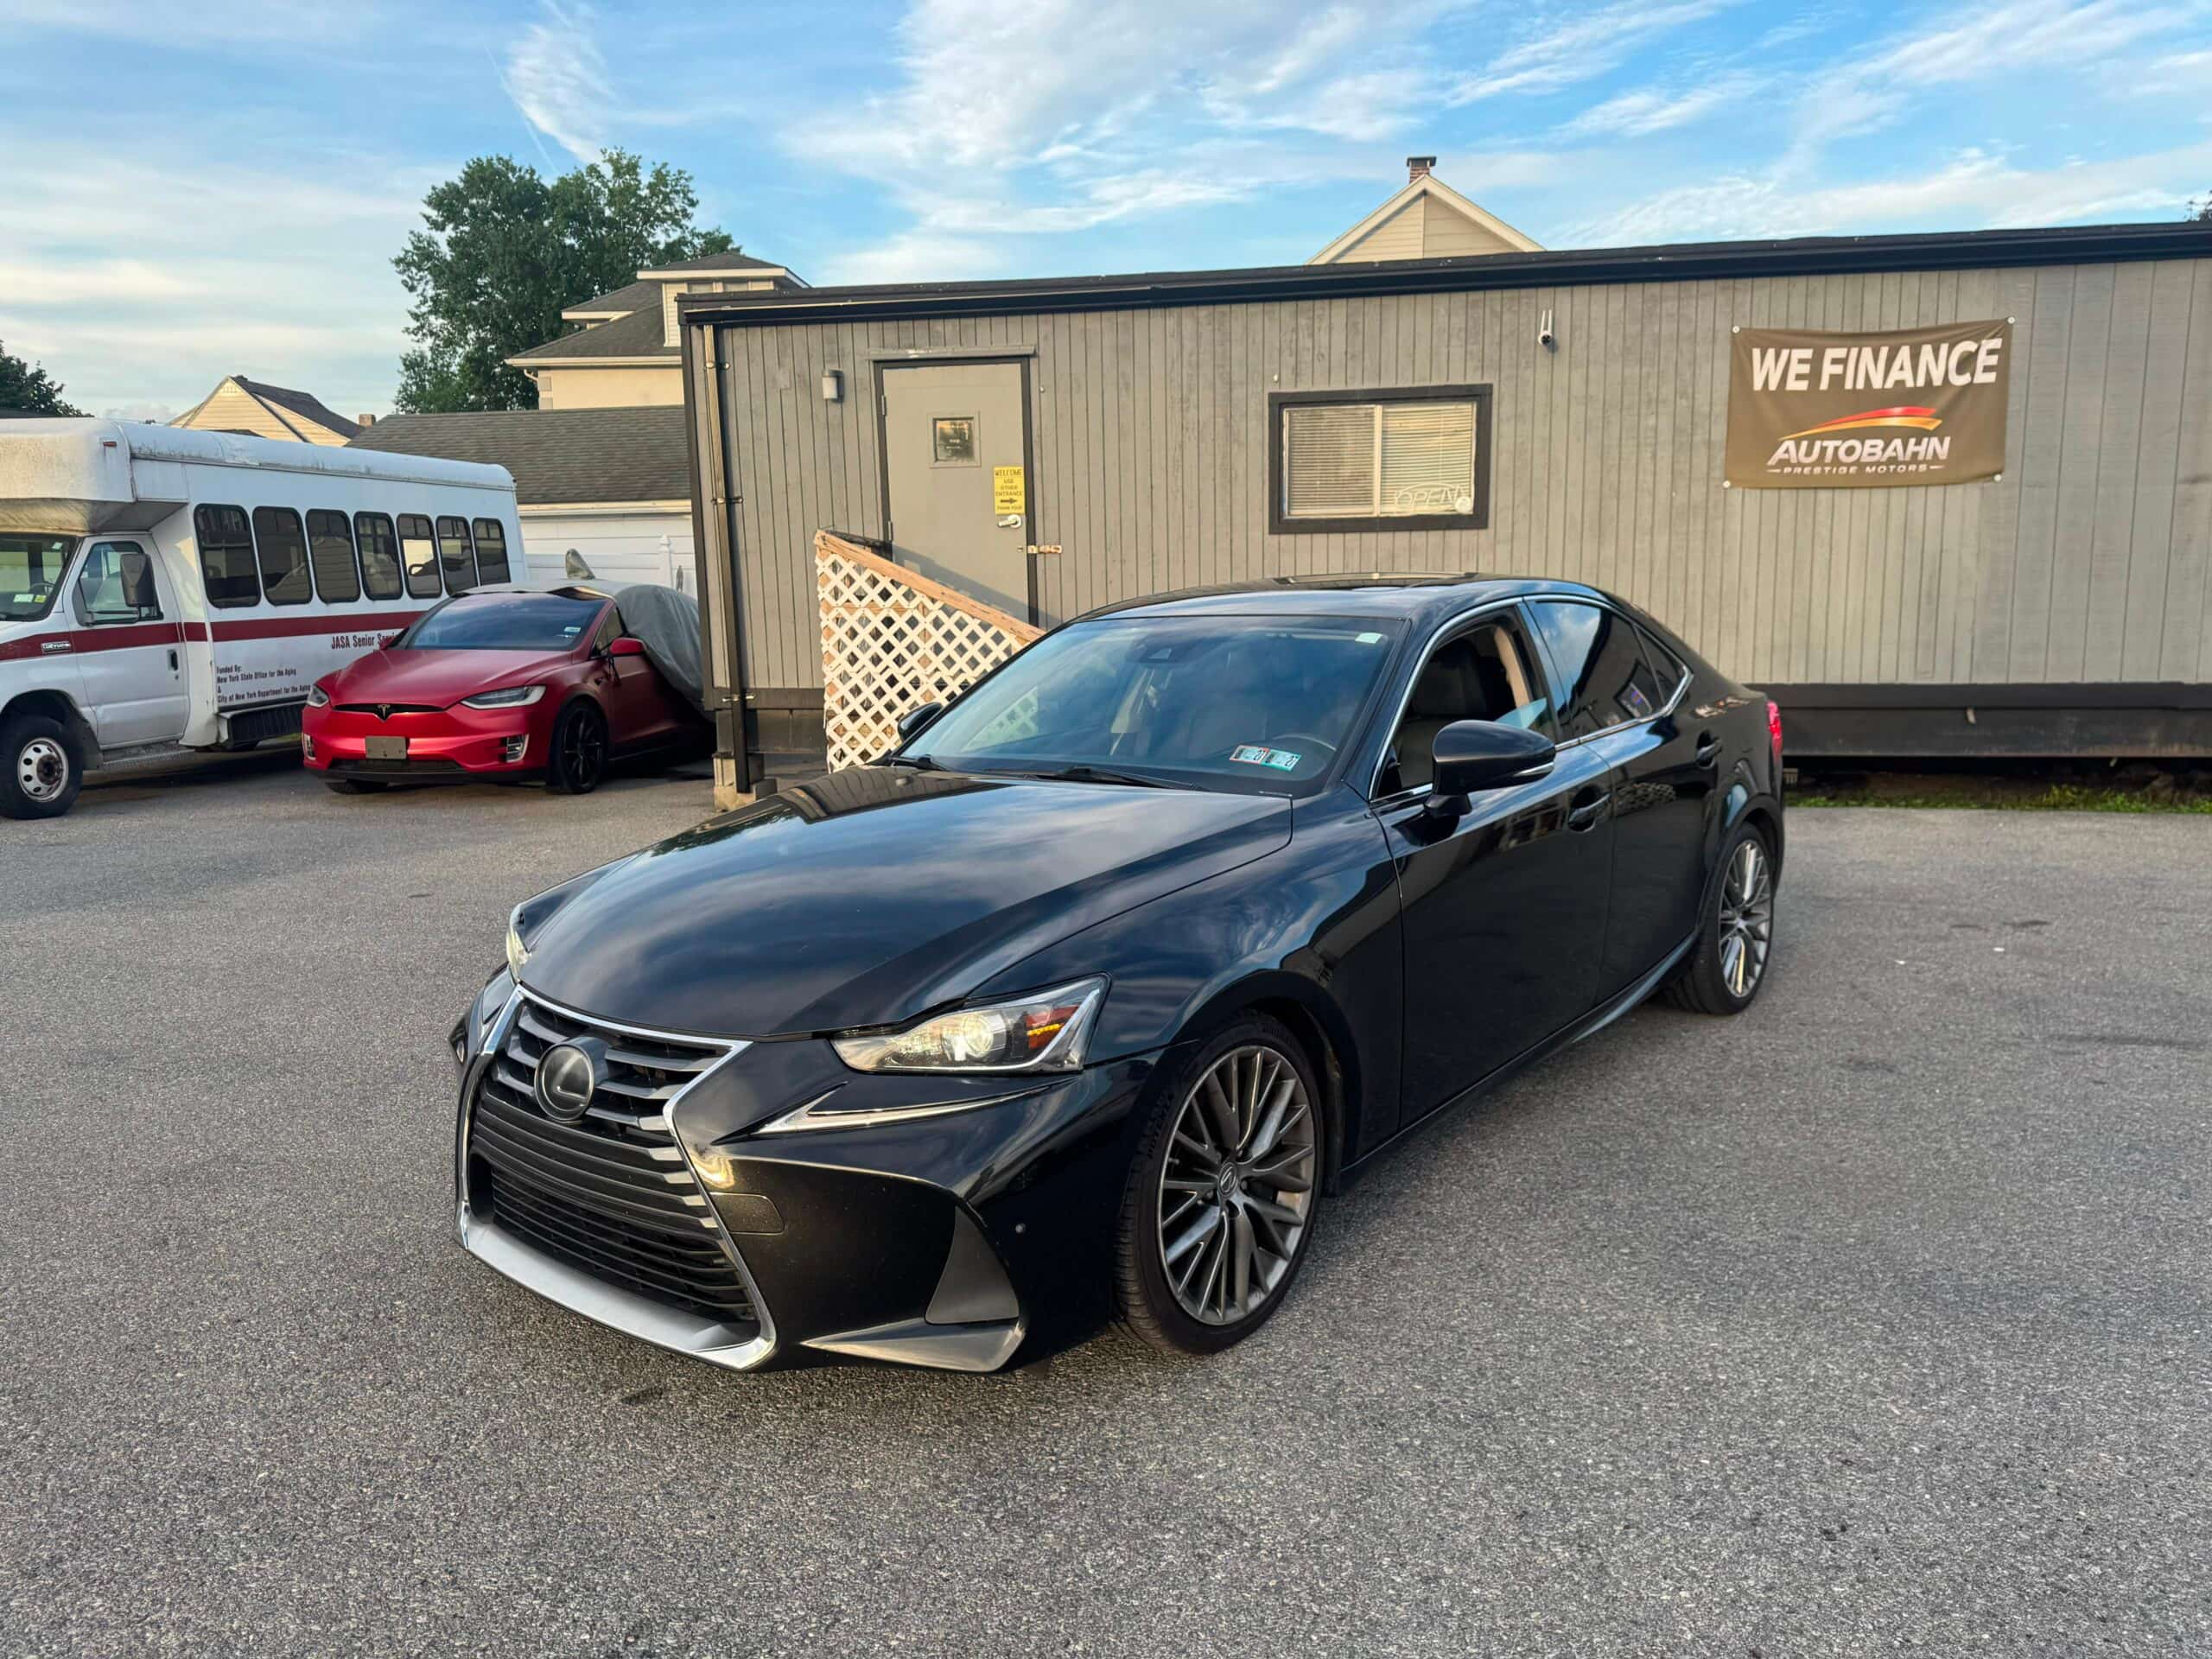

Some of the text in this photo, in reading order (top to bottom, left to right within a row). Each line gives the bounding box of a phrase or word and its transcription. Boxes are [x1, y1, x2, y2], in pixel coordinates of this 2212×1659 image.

[1751, 338, 2003, 391] WE FINANCE
[1767, 435, 1951, 466] AUTOBAHN
[1783, 464, 1928, 475] PRESTIGE MOTORS
[331, 635, 351, 650] JASA
[353, 632, 375, 647] Senior
[285, 668, 297, 677] Aging
[217, 695, 227, 703] City
[257, 688, 283, 697] Department
[299, 684, 311, 693] Aging
